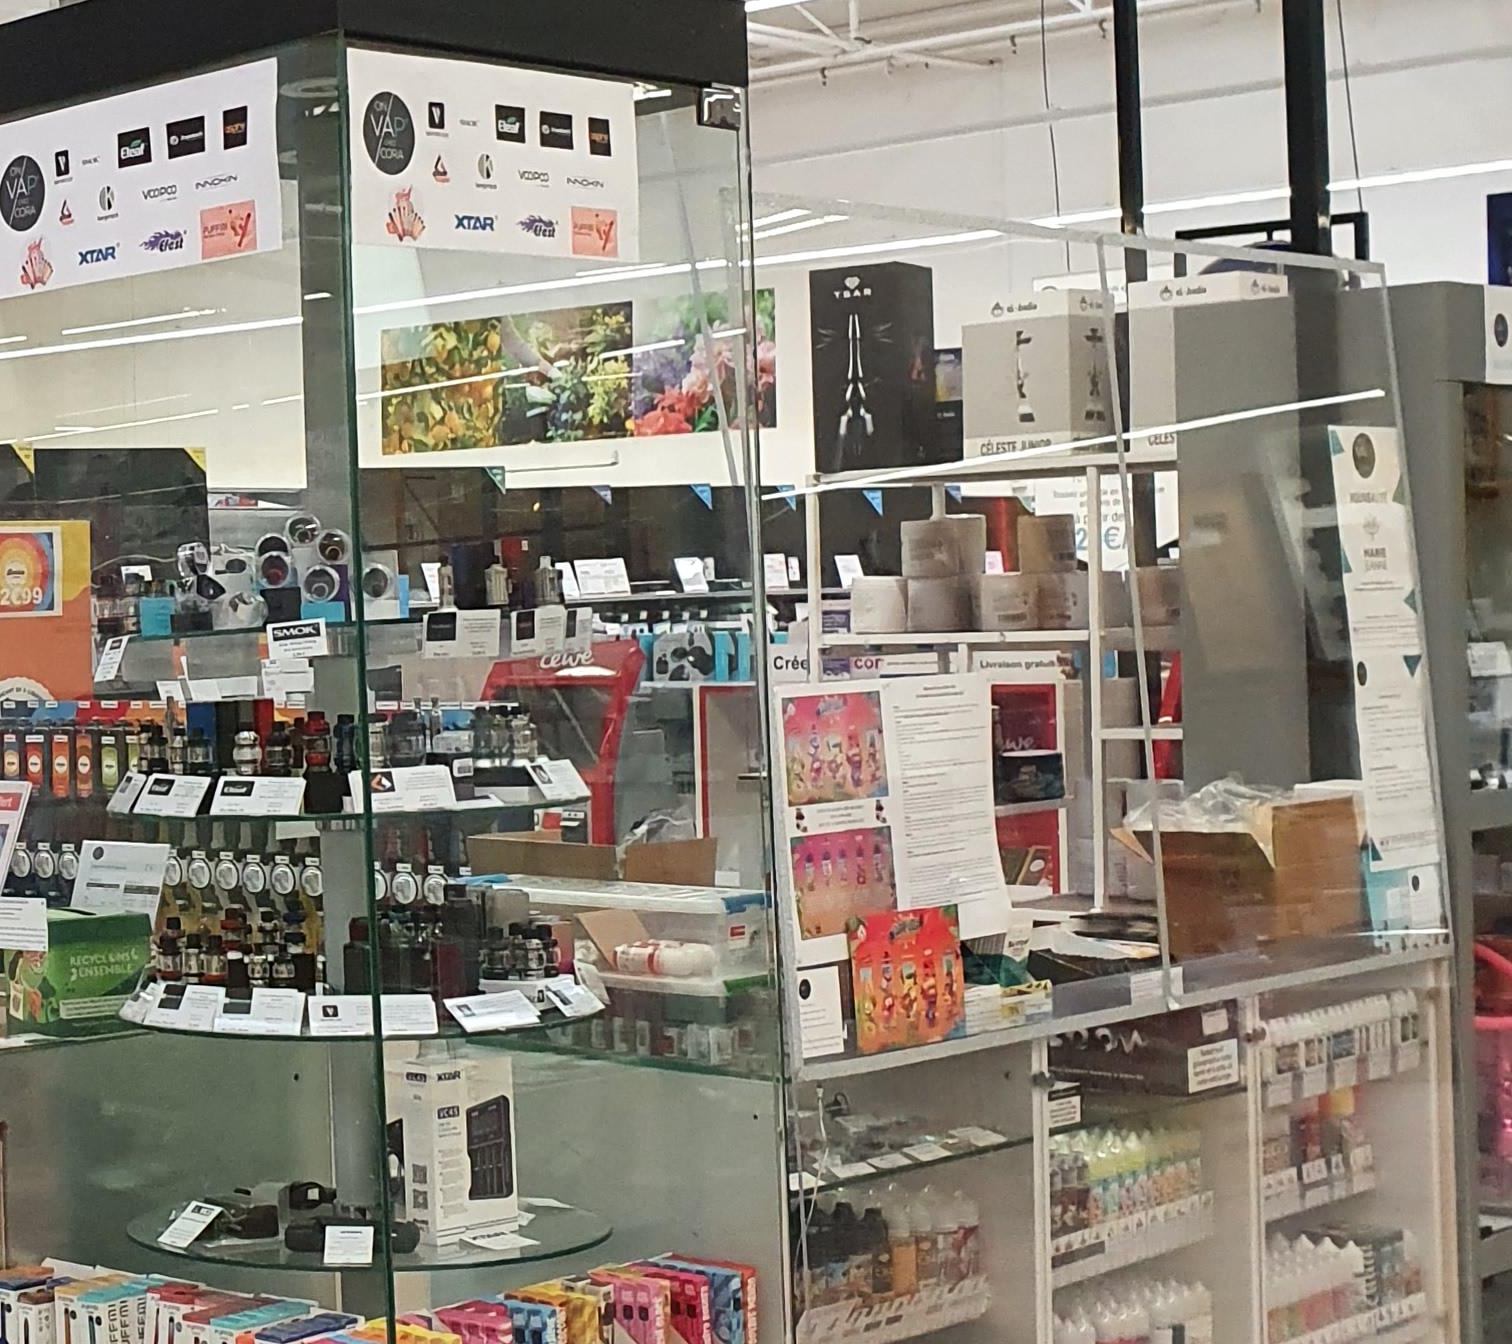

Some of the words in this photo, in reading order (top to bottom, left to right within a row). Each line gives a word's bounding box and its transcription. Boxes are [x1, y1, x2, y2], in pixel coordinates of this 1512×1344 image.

[454, 214, 495, 232] XTAR
[78, 245, 117, 267] XTAR
[273, 625, 317, 638] SMOK
[539, 648, 595, 670] cewe
[979, 658, 1023, 670] Livraison
[80, 963, 134, 979] ENSEMBLE
[437, 1070, 462, 1082] XTAR
